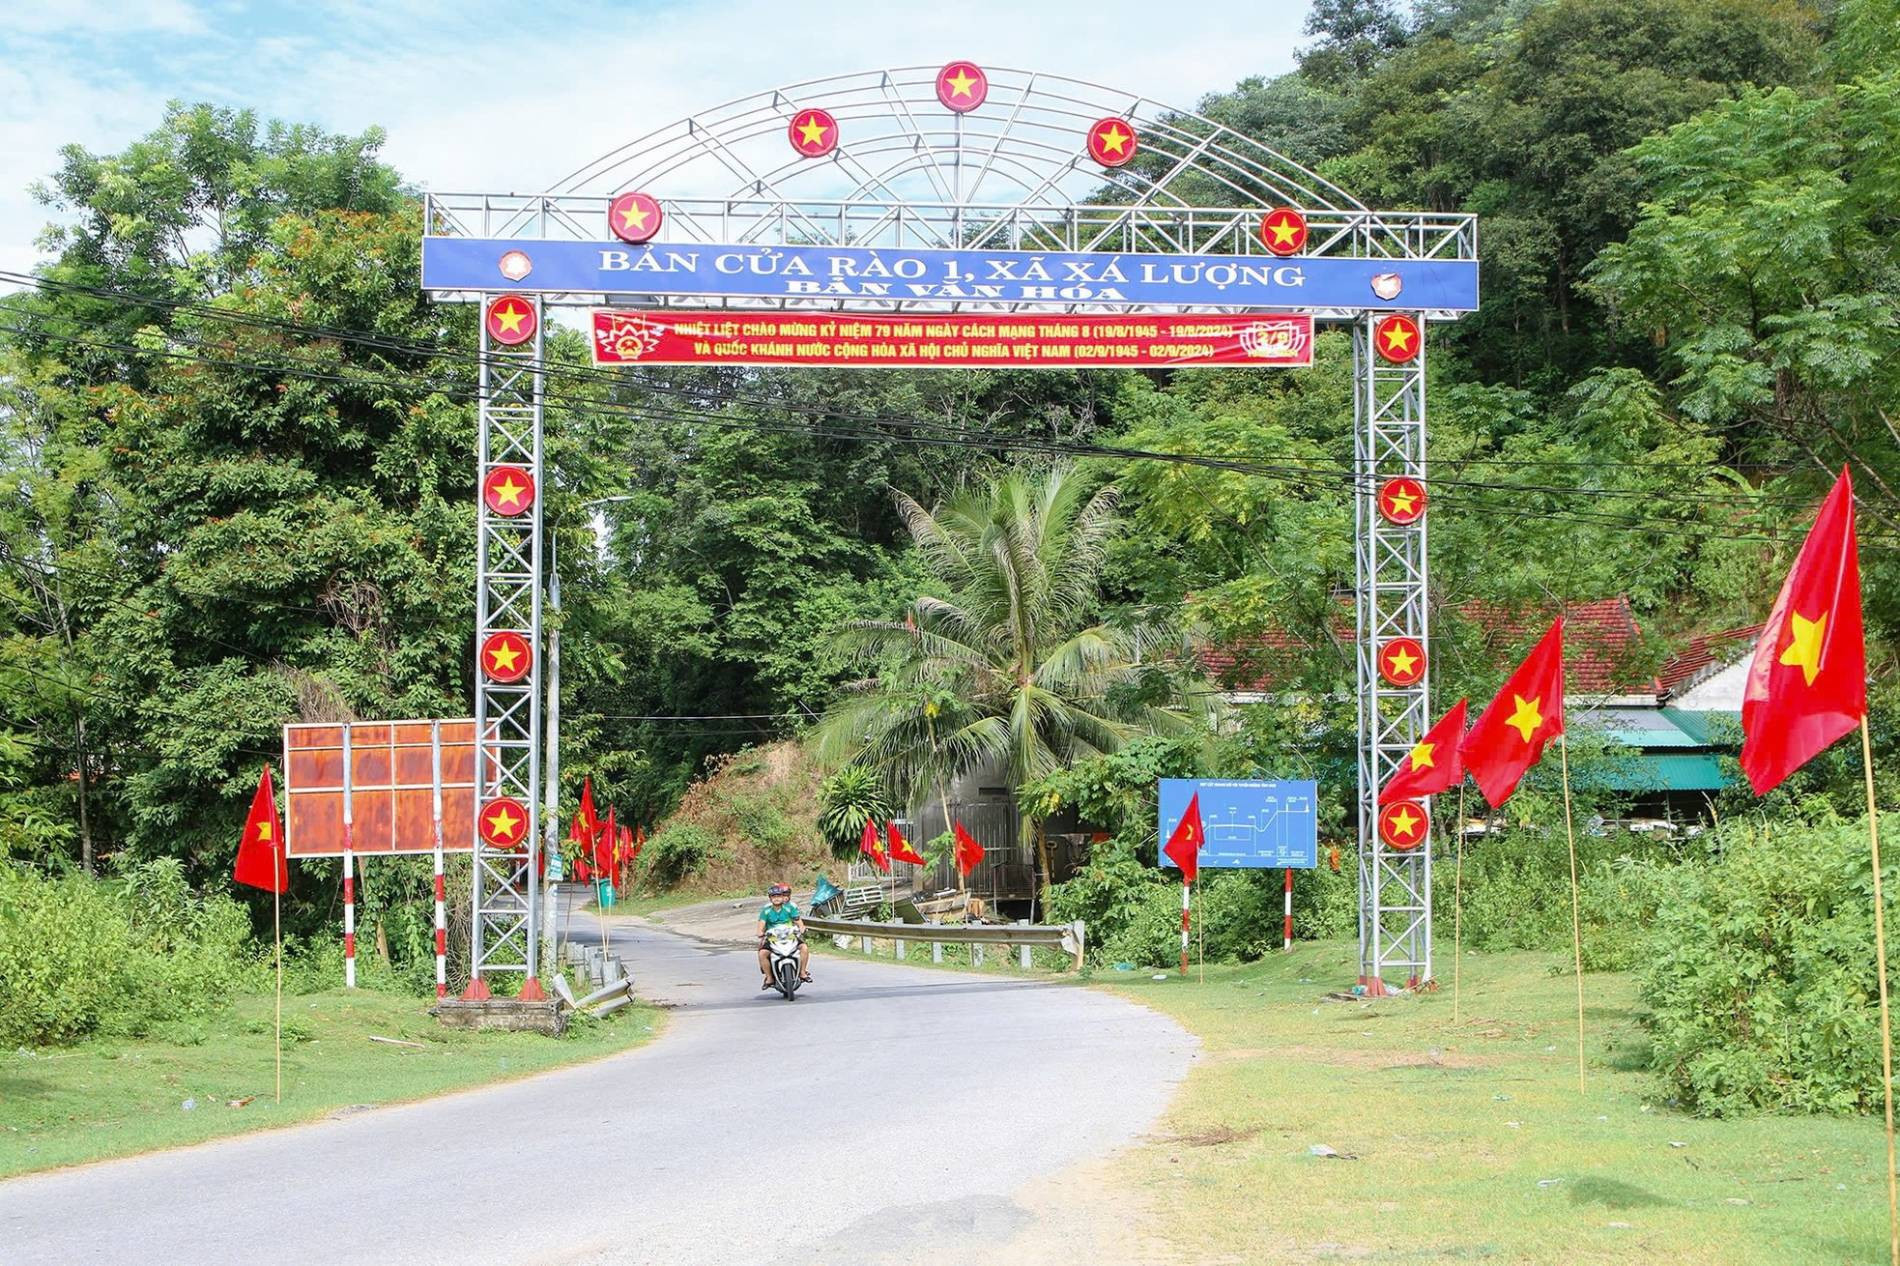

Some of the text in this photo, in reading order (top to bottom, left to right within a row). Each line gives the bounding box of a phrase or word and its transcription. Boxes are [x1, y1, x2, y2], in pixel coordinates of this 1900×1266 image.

[598, 245, 1305, 290] BẢN CỬA RÀO 1, XÃ XÁ LƯỢNG
[786, 277, 1127, 301] BẢN VĂN HÓA
[674, 321, 710, 338] NHIỆT
[715, 321, 740, 338] LIỆT
[742, 322, 776, 337] CHÀO
[779, 322, 817, 337] MỪNG
[820, 321, 837, 337] KỶ
[840, 322, 872, 339] NIỆM
[875, 324, 890, 337] 79
[893, 323, 923, 338] NĂM
[926, 323, 959, 338] NGÀY
[962, 323, 995, 338] CÁCH
[999, 324, 1035, 340] MẠNG
[1039, 323, 1078, 338] THÁNG
[1082, 325, 1090, 338] 8
[1093, 325, 1157, 339] (19/8/1945
[694, 341, 712, 356] VÀ
[714, 339, 748, 356] QUỐC
[751, 342, 793, 356] KHÁNH
[796, 341, 831, 357] NƯỚC
[834, 342, 868, 359] CỘNG
[900, 342, 917, 358] XÃ
[919, 343, 941, 360] HỘI
[943, 341, 969, 358] CHỦ
[972, 342, 1009, 358] NGHĨA
[1013, 342, 1038, 360] VIỆT
[1041, 345, 1070, 358] NAM
